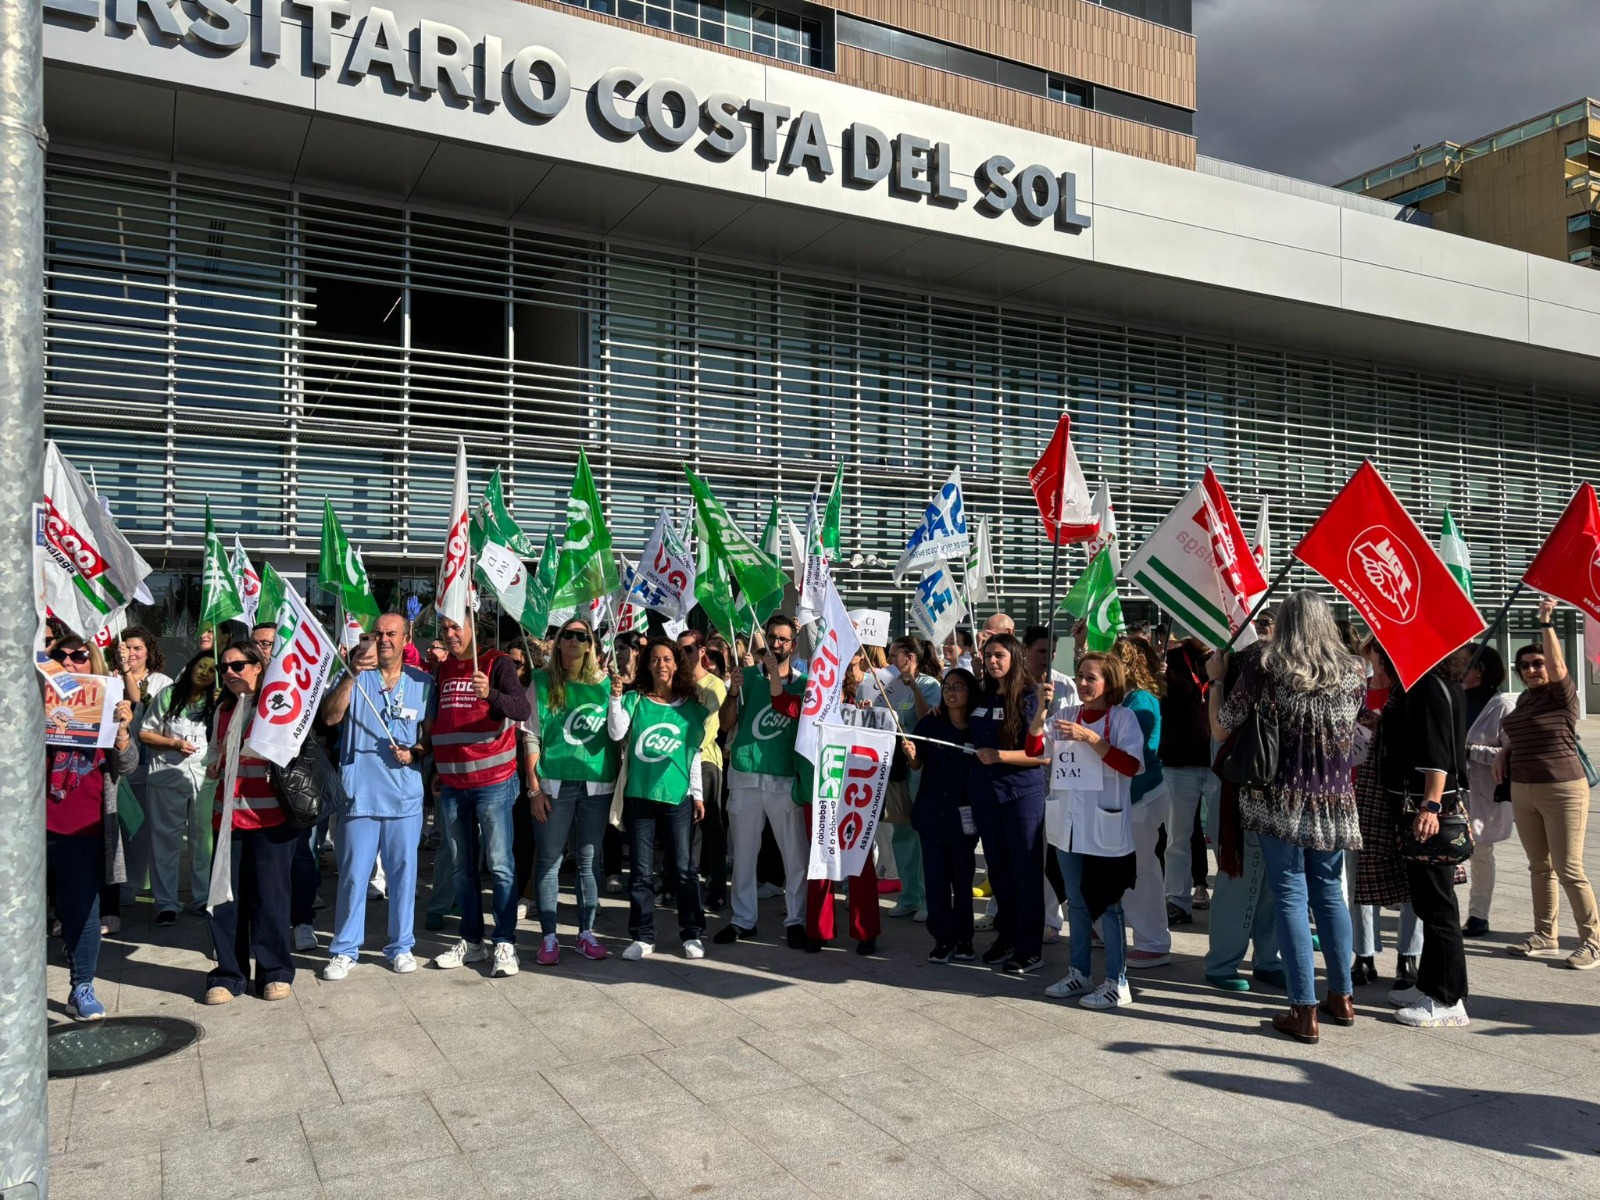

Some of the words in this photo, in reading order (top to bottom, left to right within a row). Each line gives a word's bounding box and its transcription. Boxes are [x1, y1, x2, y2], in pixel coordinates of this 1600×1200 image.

[43, 0, 571, 118] SITARIO
[598, 66, 834, 175] COSTA
[851, 121, 968, 202] DEL
[985, 154, 1092, 229] SOL
[711, 511, 762, 567] CSIF
[1375, 538, 1411, 593] UGT
[1337, 578, 1382, 631] málaga
[865, 616, 875, 626] C1
[860, 628, 877, 637] ¡YA!
[573, 715, 607, 733] CSIF
[761, 712, 793, 729] CSIF
[644, 733, 682, 753] CSIF
[1058, 751, 1075, 763] C1
[1055, 767, 1081, 780] ¡YA!
